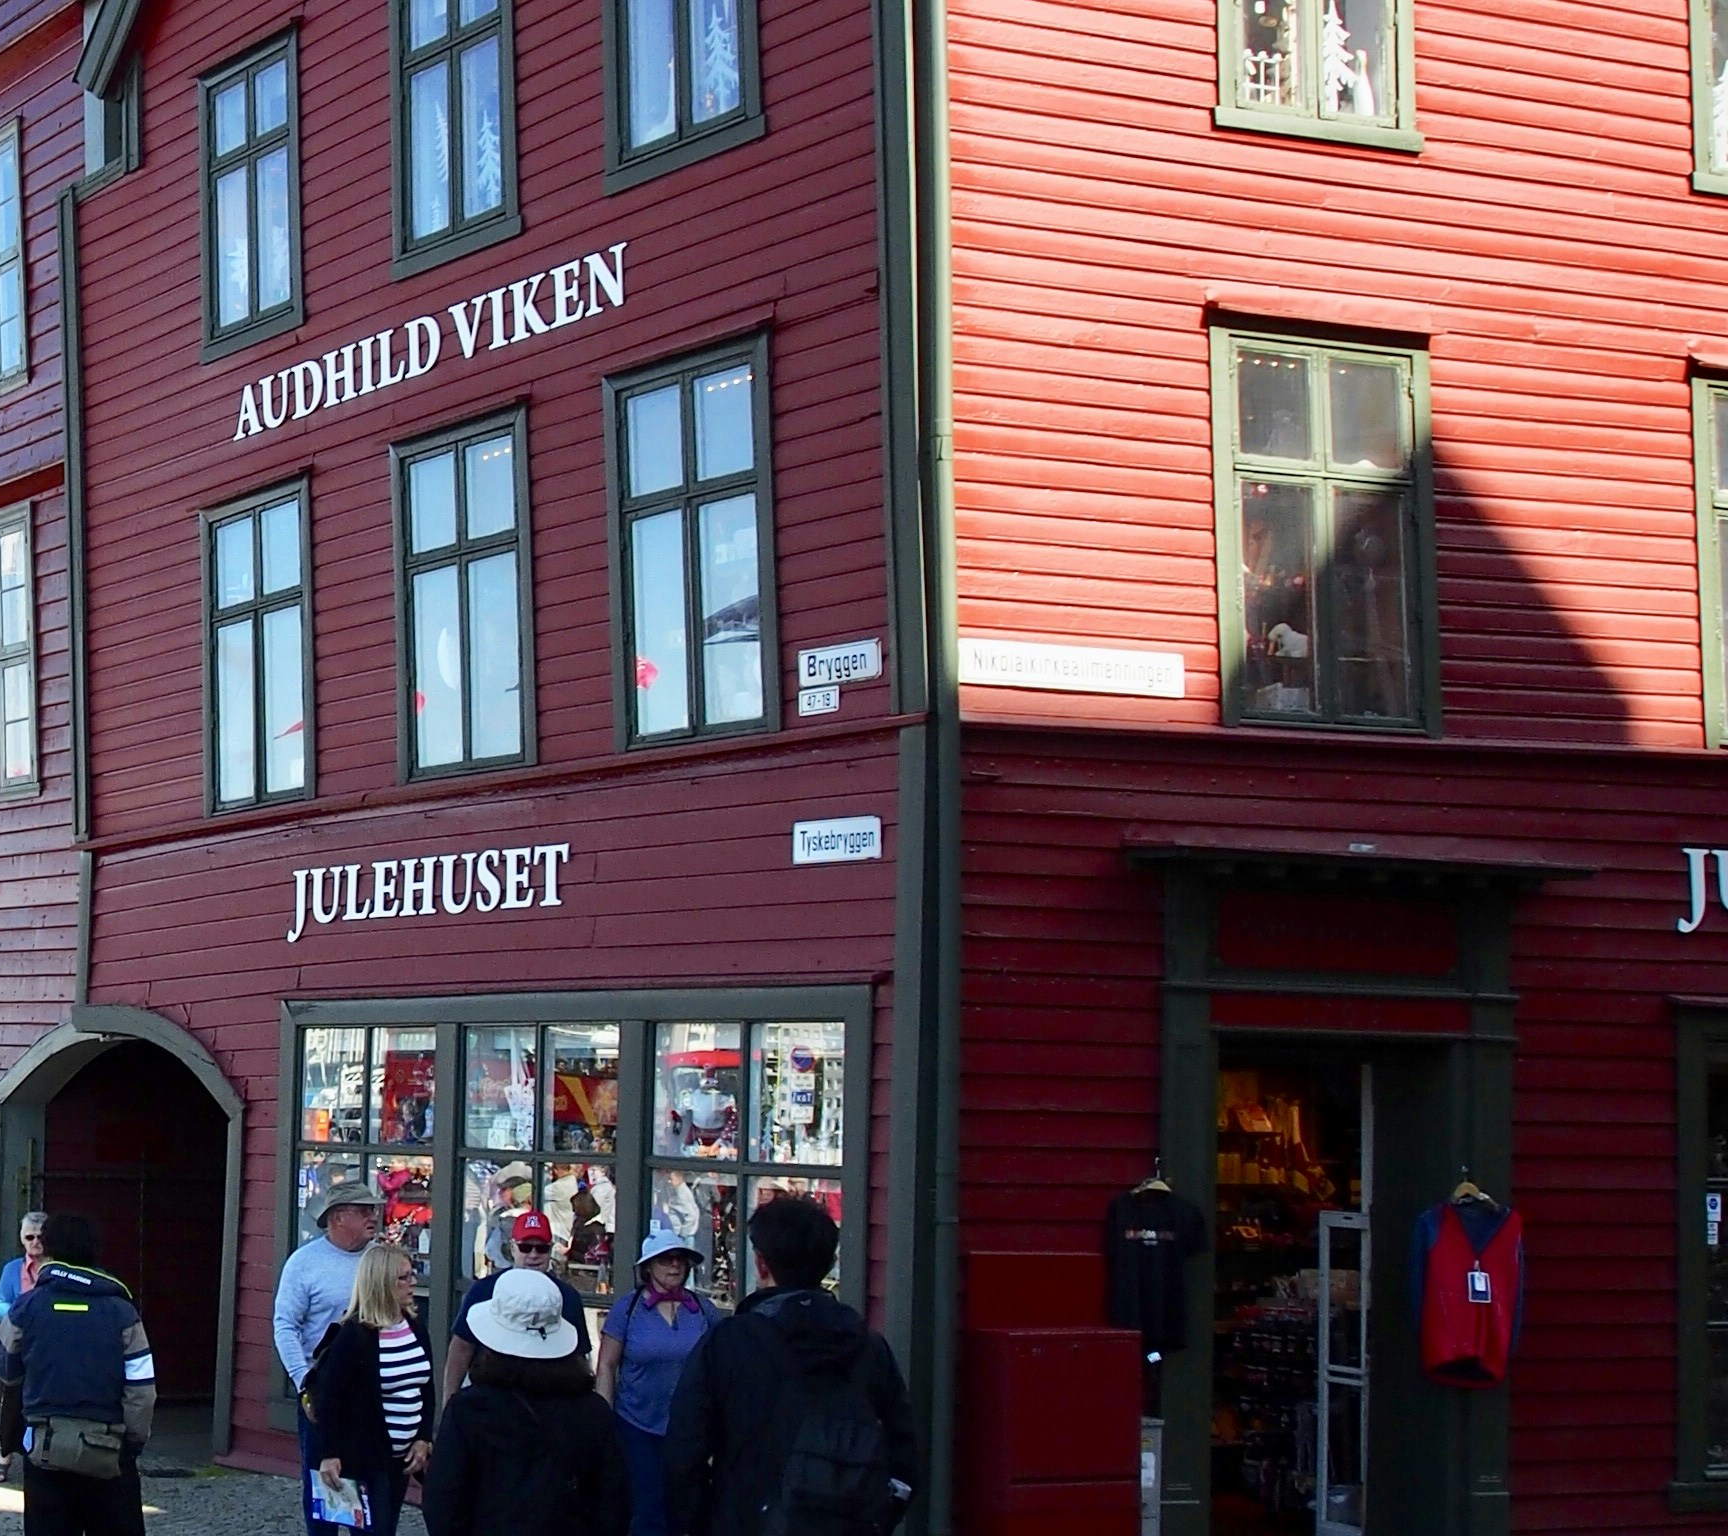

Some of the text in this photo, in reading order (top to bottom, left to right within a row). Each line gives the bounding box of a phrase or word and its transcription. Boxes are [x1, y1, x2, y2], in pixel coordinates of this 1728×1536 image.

[233, 243, 628, 441] AUDHILD VIKEN
[807, 652, 867, 680] Bryggen
[800, 830, 875, 857] Tyskebryggen
[287, 843, 569, 943] JULEHUSET
